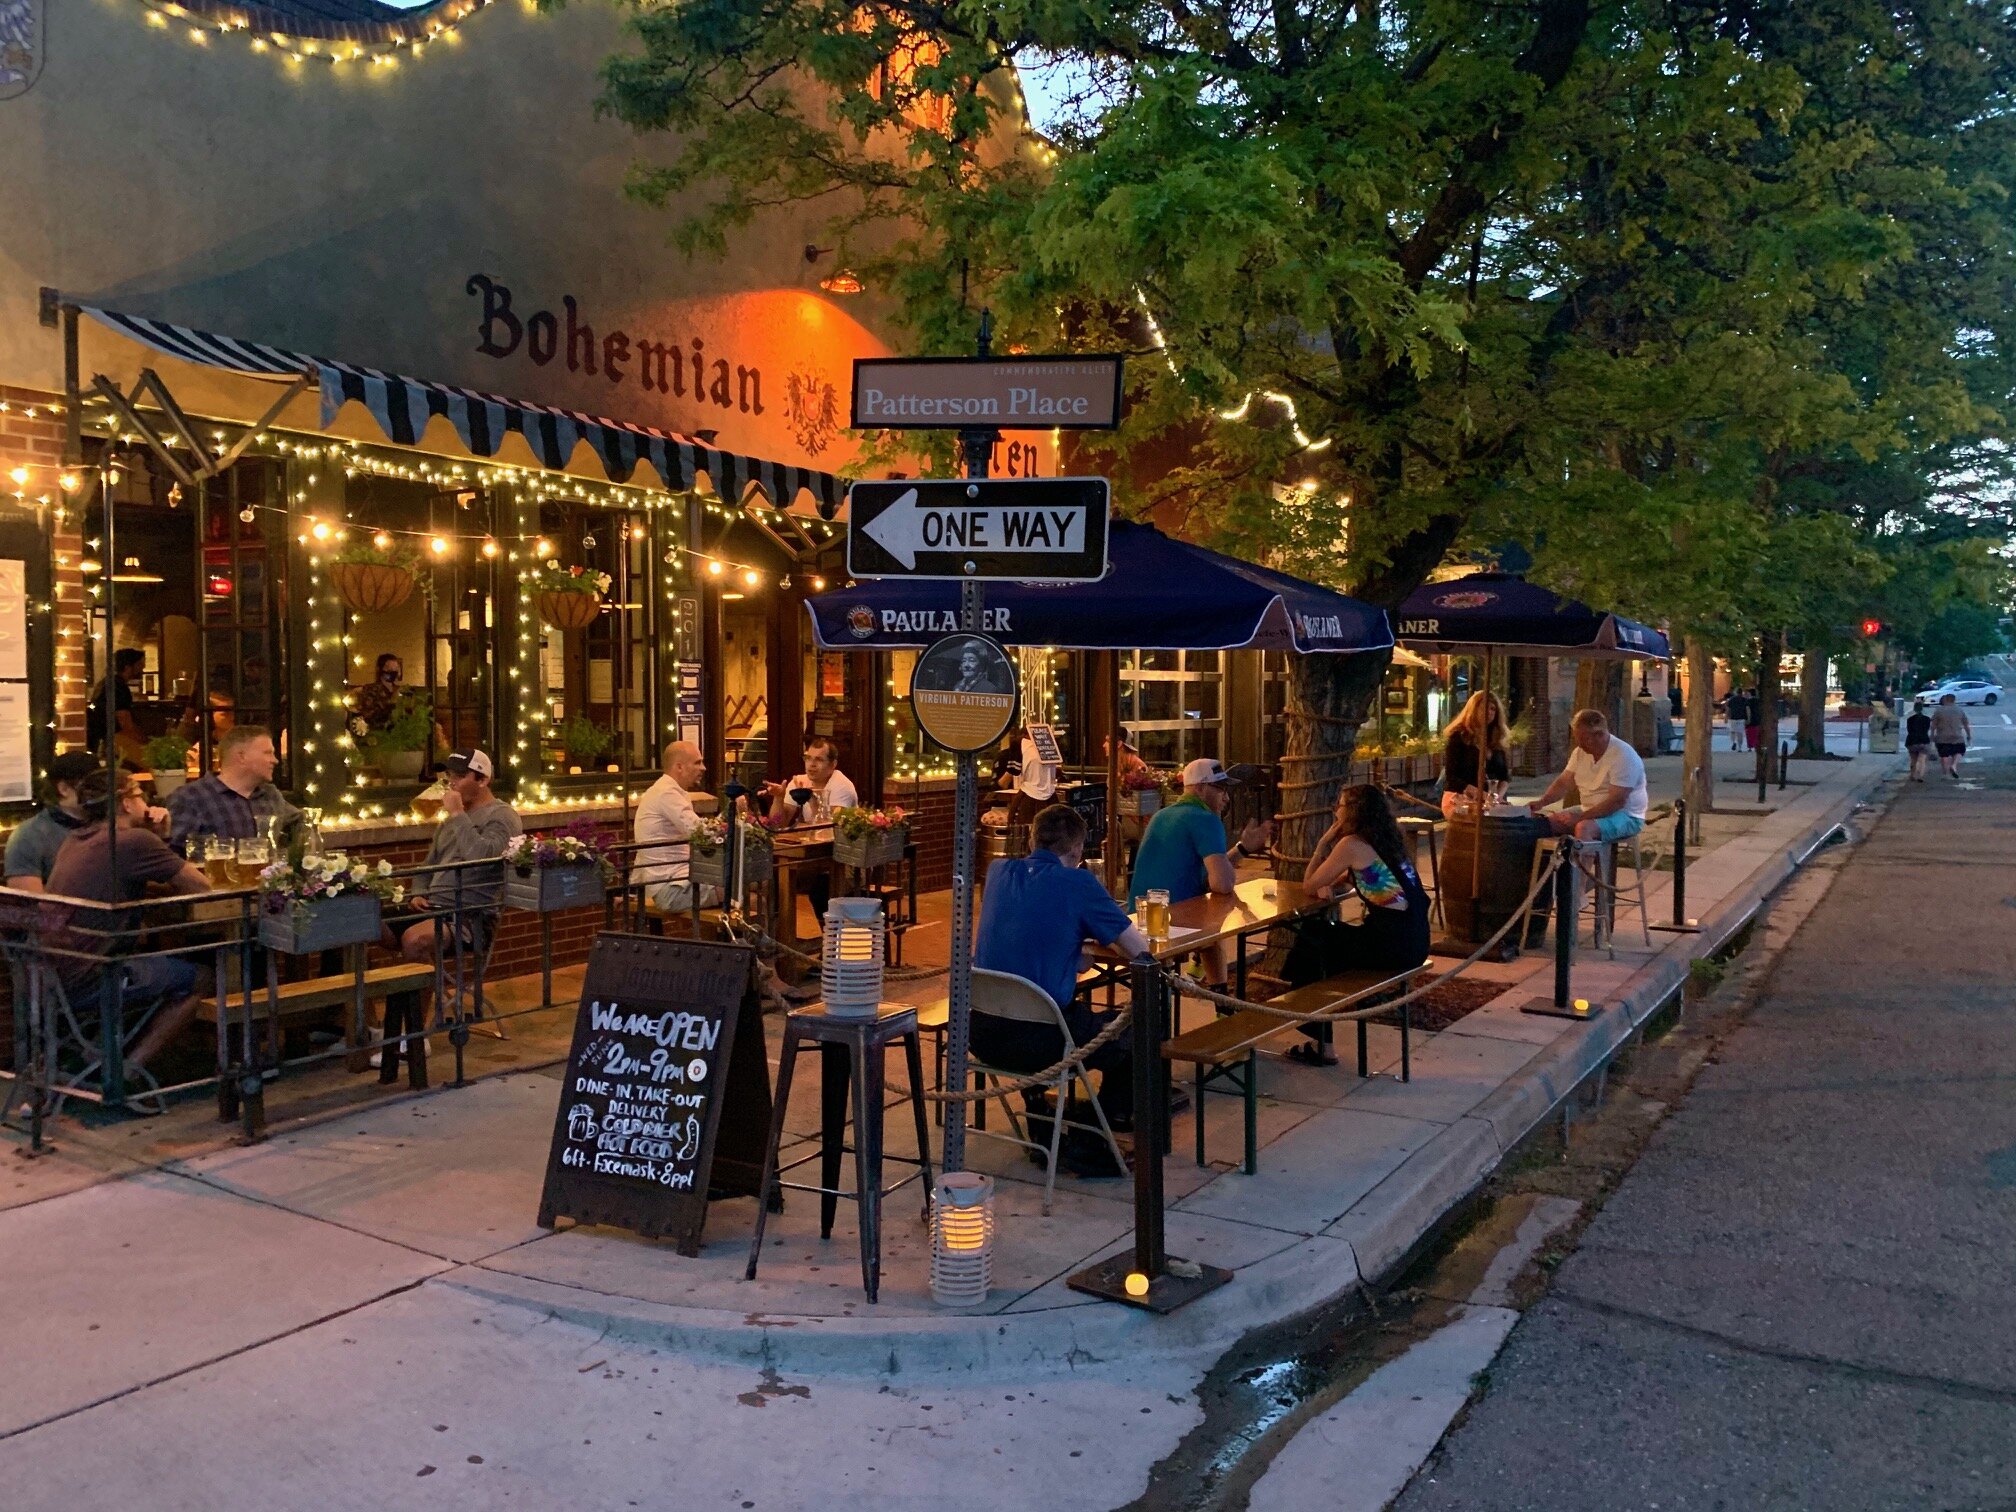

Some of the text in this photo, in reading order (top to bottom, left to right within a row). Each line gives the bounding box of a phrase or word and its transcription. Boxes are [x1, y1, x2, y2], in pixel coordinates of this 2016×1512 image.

[467, 274, 764, 415] Bohemian
[865, 388, 1088, 416] Patterson Place
[922, 511, 1077, 547] ONE WAY
[881, 607, 1012, 632] PAULAER
[1398, 618, 1440, 634] ANER
[919, 694, 1008, 707] VIRGINIA PATTERSON
[622, 1014, 660, 1037] ARE
[655, 1011, 721, 1051] OPEN
[636, 1085, 705, 1109] TAKE-OUT
[608, 1100, 669, 1121] DELIVERY
[602, 1115, 683, 1142] COLD BIER
[598, 1132, 673, 1158] HOT FOOD
